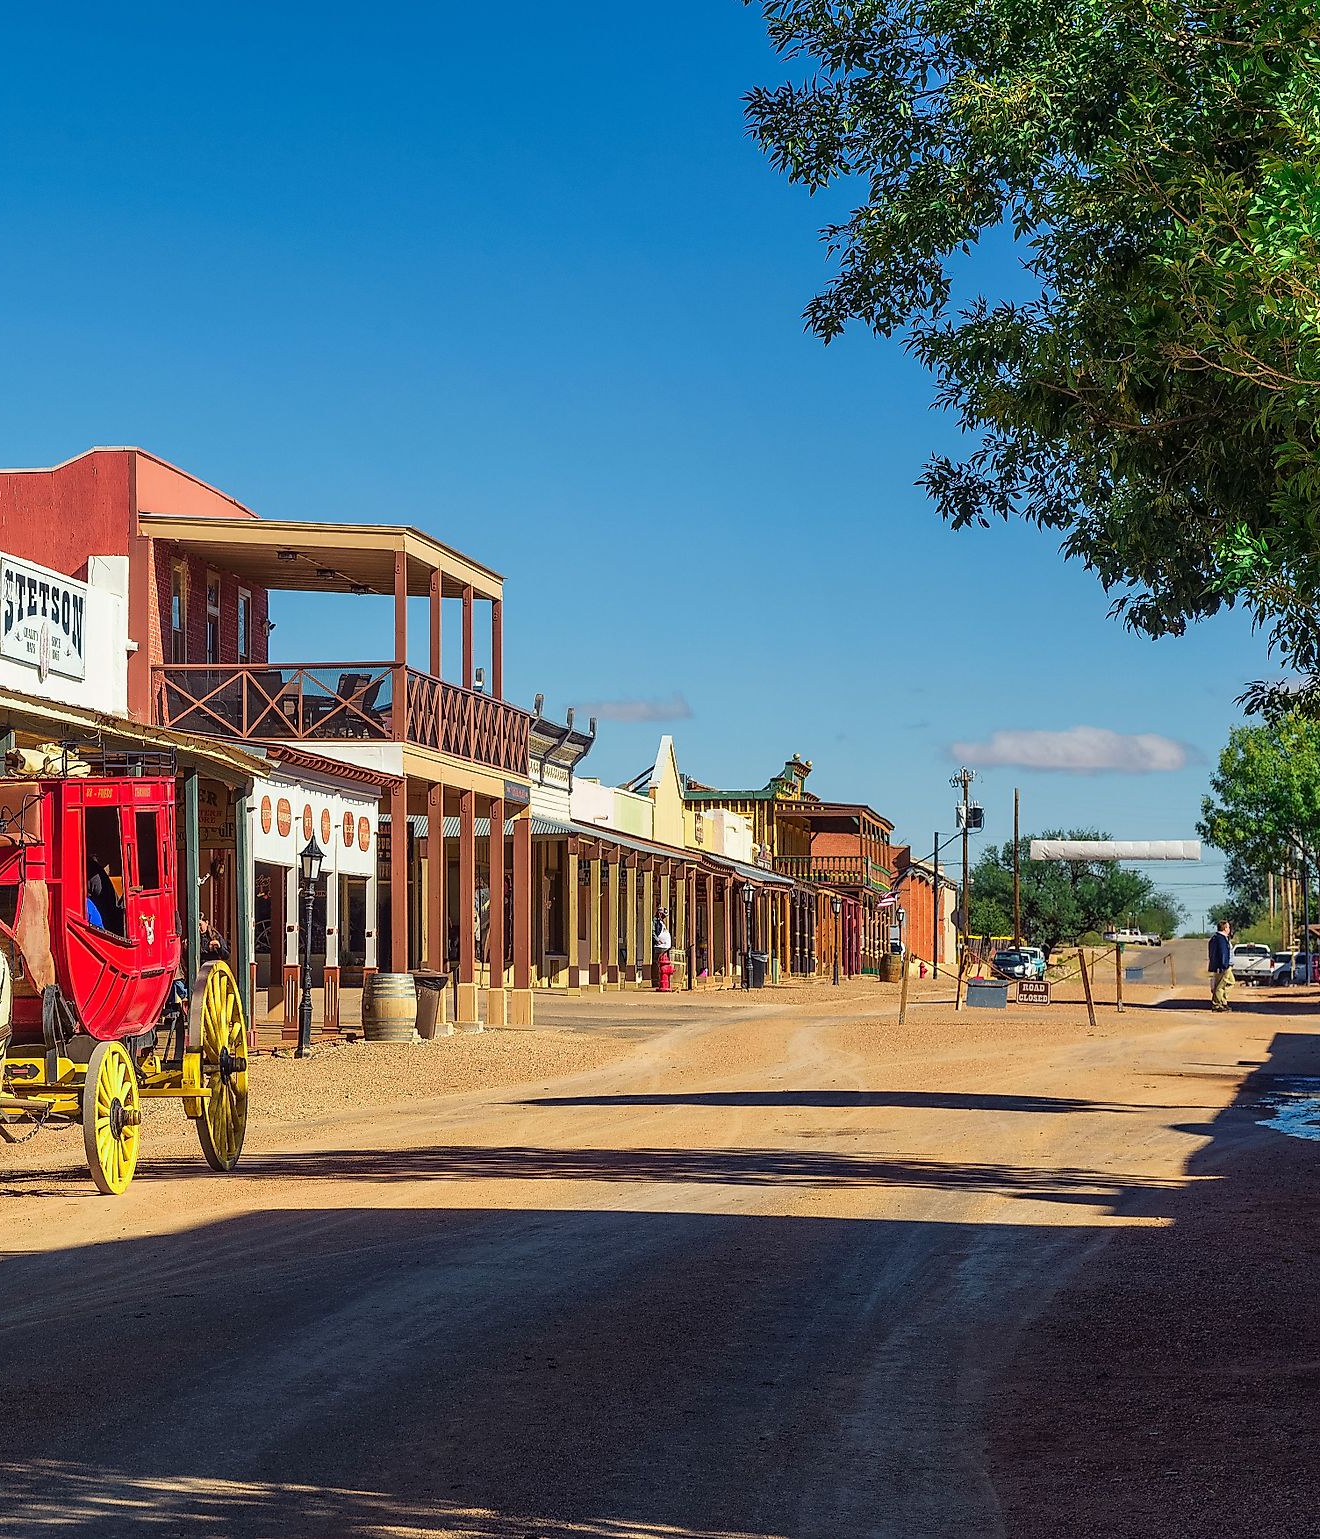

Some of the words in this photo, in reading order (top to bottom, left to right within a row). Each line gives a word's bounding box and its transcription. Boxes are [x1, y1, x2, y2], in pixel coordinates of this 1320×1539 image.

[4, 568, 84, 660] STETSON
[1022, 983, 1045, 992] ROAD
[1018, 993, 1048, 1003] CLOSED
